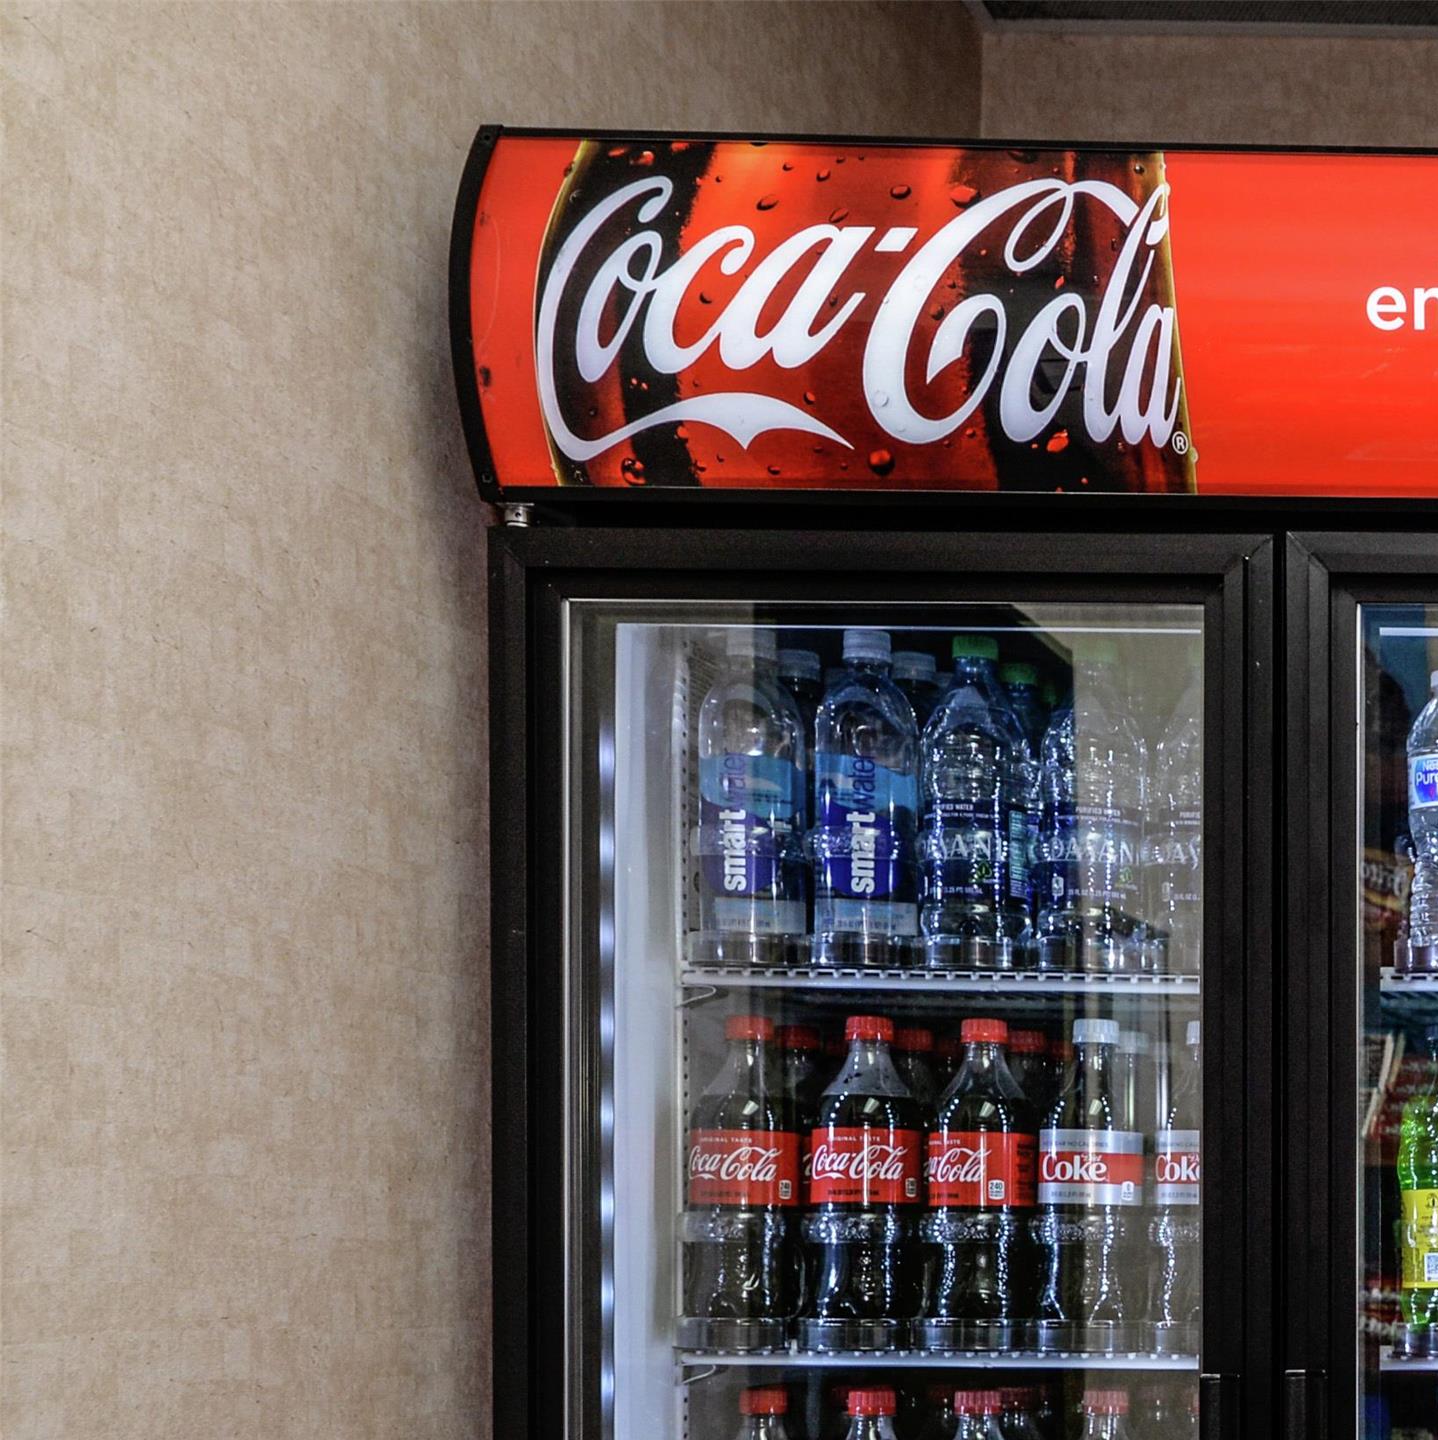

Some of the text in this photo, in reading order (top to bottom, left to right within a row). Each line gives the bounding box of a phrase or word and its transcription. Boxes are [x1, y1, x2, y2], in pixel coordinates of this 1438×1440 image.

[539, 174, 1181, 461] Coca-Cola
[812, 1144, 908, 1180] Coca-Cola
[1042, 1153, 1108, 1181] Coke
